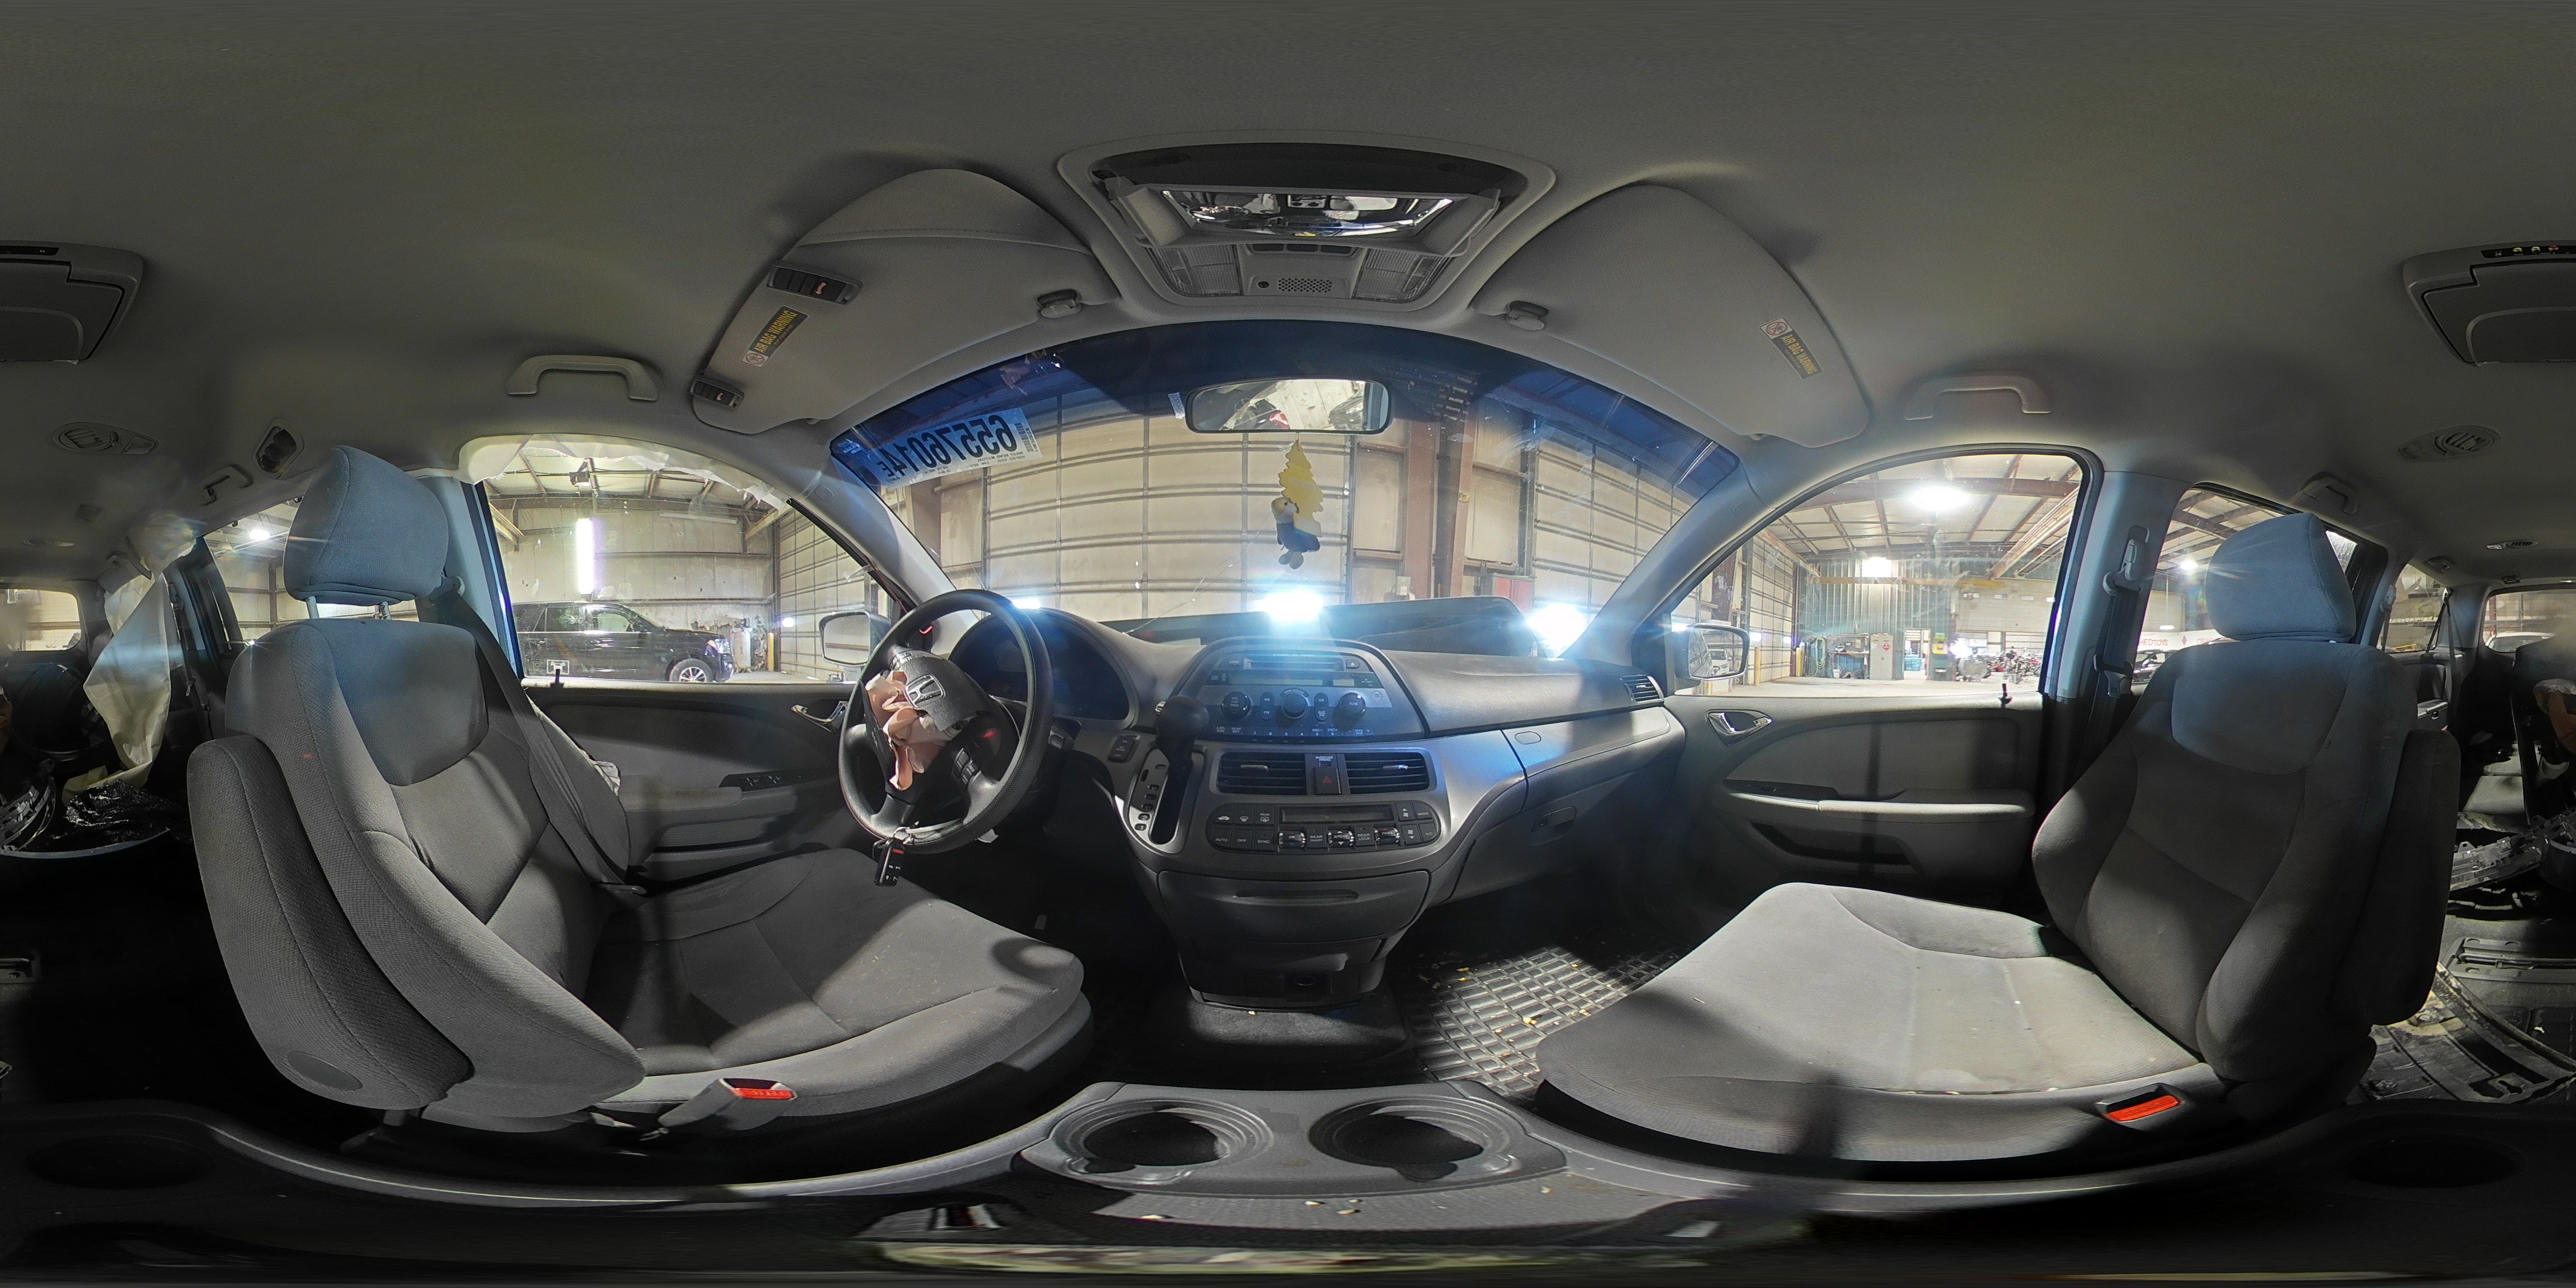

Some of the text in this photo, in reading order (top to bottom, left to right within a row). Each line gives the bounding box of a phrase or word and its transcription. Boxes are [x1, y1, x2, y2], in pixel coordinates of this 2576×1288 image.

[754, 310, 798, 353] AIR BAG WARNING
[1780, 334, 1796, 345] AIR
[1788, 342, 1804, 355] BAG
[1796, 353, 1817, 374] WARNING
